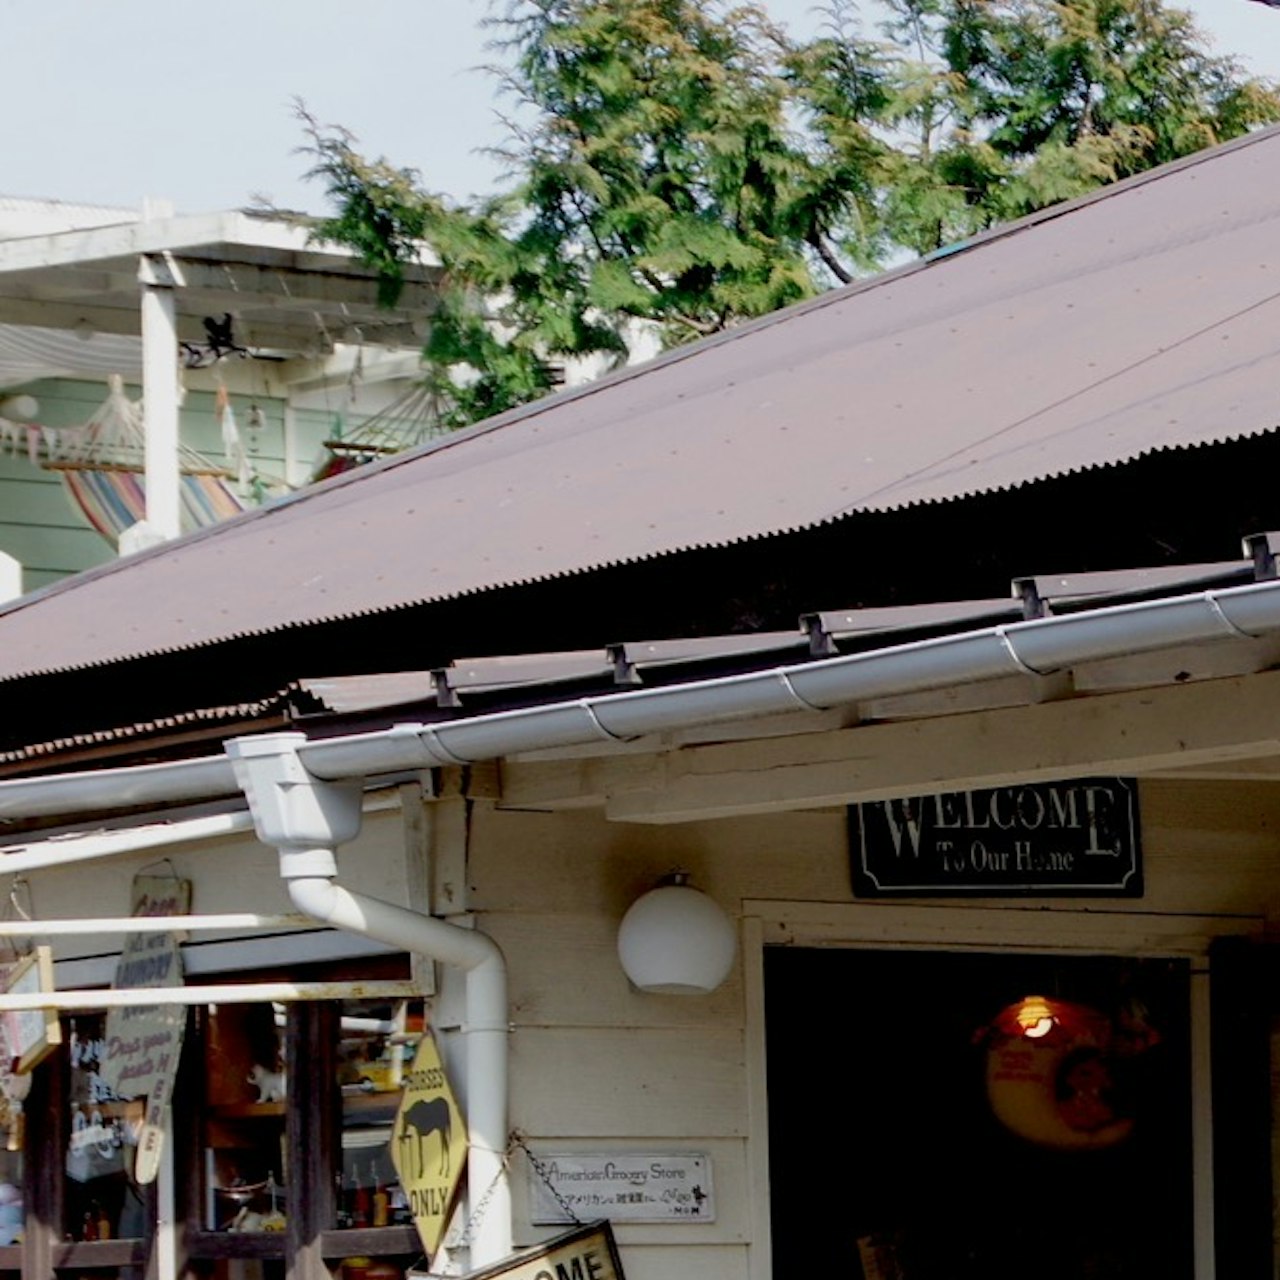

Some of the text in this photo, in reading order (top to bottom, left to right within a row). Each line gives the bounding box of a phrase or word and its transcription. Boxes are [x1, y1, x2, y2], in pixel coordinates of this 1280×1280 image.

[877, 785, 1121, 857] WELCOME
[970, 841, 1009, 871] Our
[1015, 841, 1075, 871] Home
[650, 1163, 686, 1181] Store
[410, 1186, 448, 1218] ONLY
